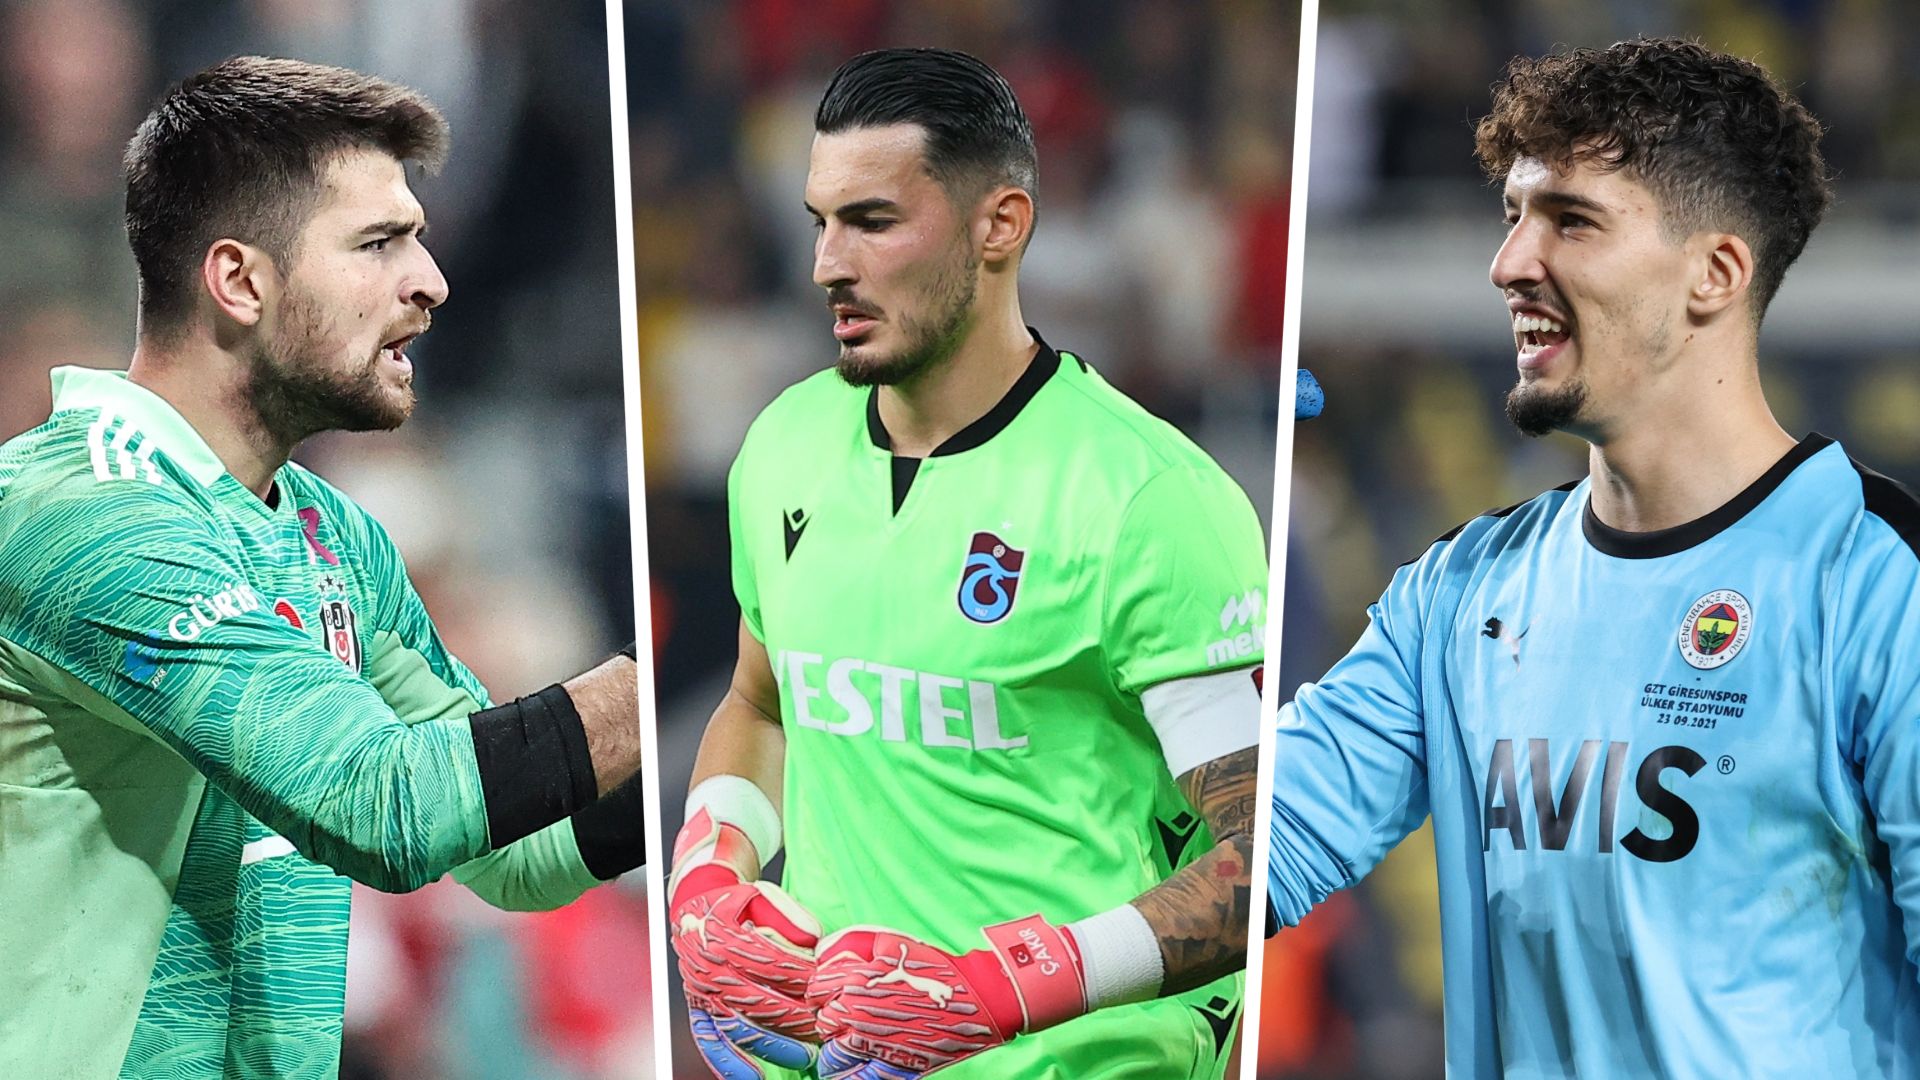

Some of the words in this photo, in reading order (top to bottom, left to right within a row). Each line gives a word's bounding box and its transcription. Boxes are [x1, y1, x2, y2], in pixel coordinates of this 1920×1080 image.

[1681, 593, 1721, 649] FENERBAHÇE
[1725, 593, 1746, 612] SPOR
[1206, 622, 1265, 668] mel
[1696, 655, 1714, 667] 1907
[1641, 695, 1675, 711] ÜLKER
[1677, 701, 1744, 718] STADYUMU
[1644, 683, 1667, 694] GZT
[1668, 684, 1748, 705] GİRESUNSPOR
[1657, 713, 1671, 724] 23
[1674, 715, 1717, 729] 09.2021
[1483, 738, 1707, 863] AVIS
[1018, 927, 1061, 976] ÇAKIR
